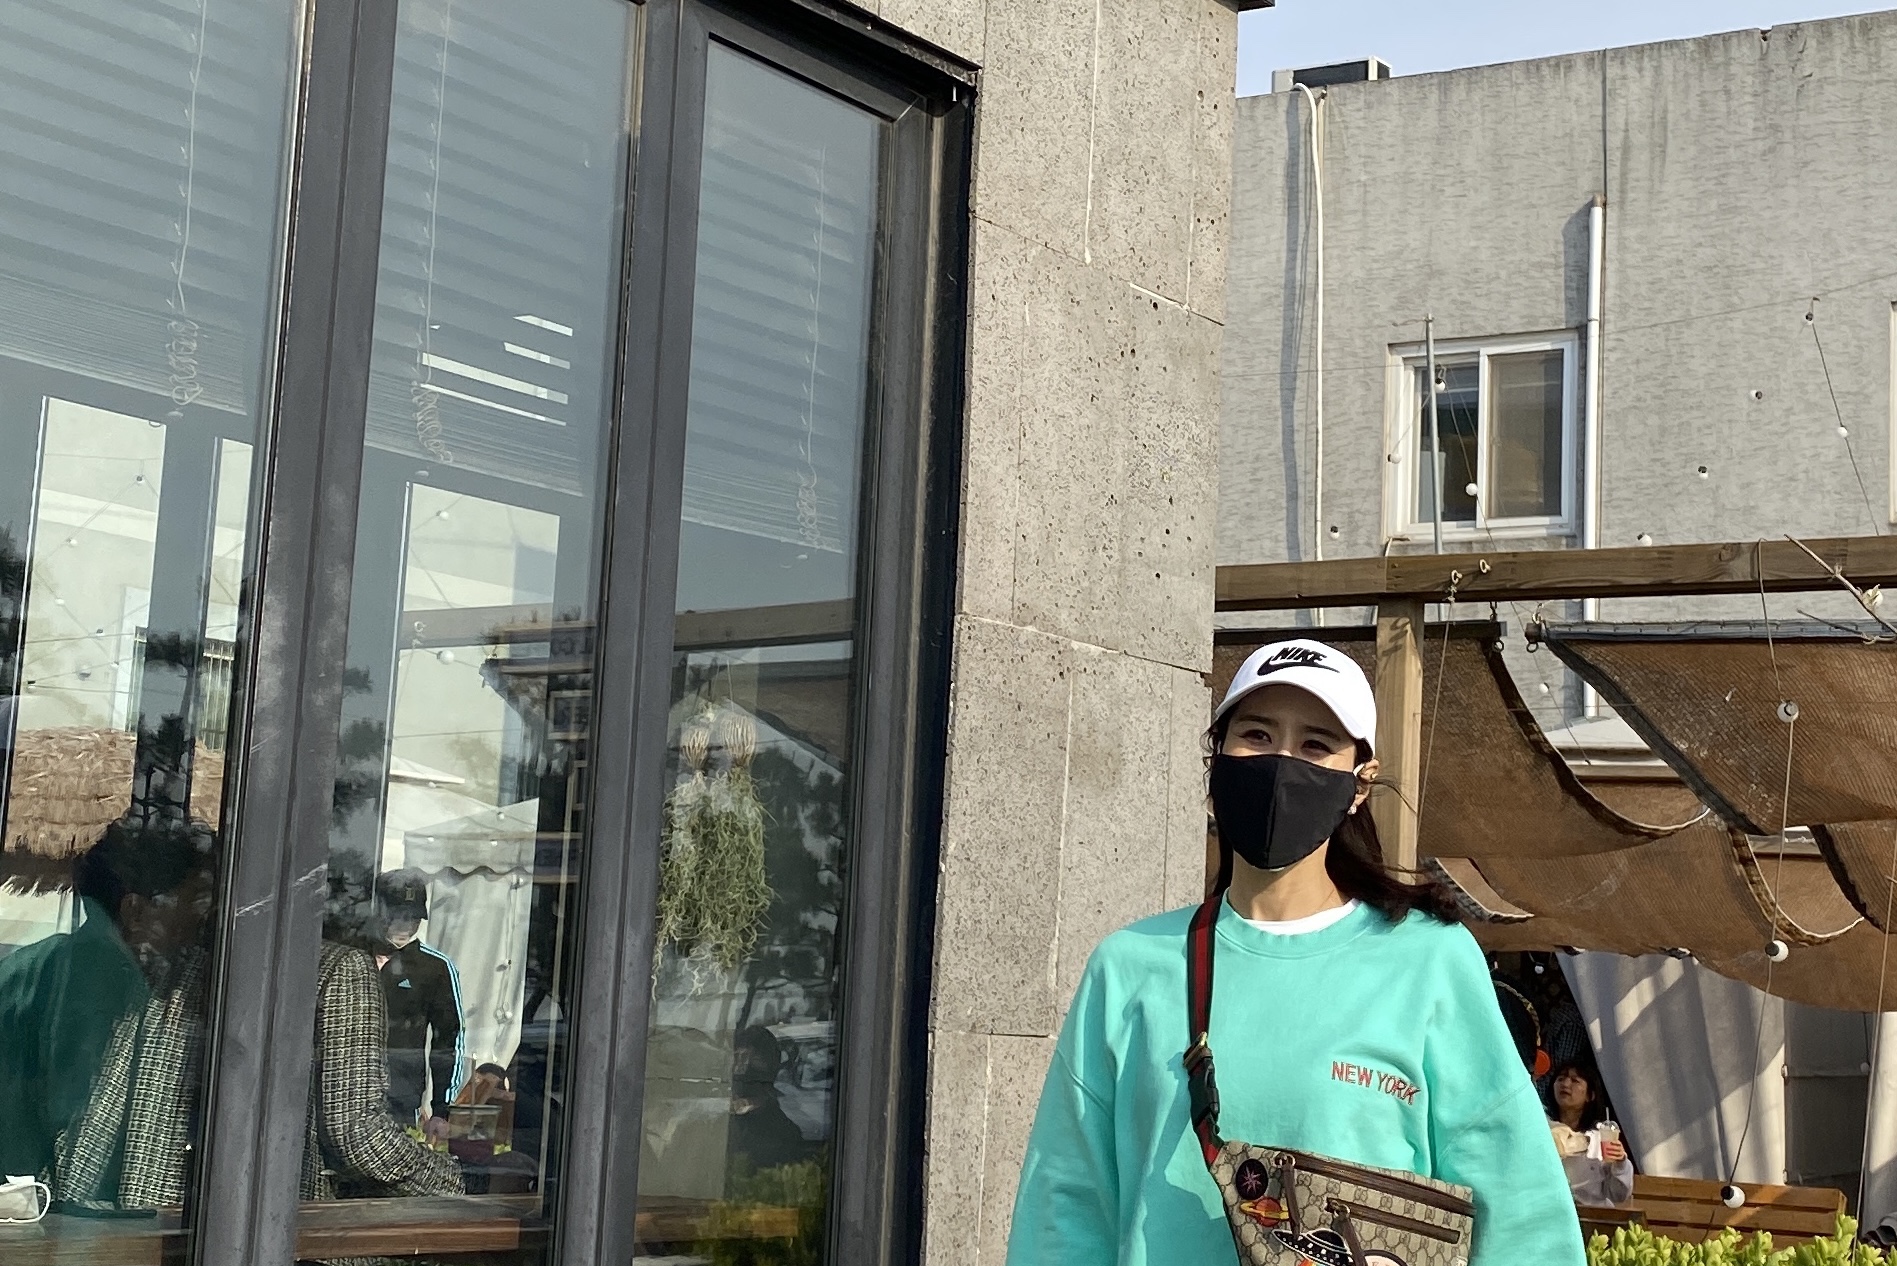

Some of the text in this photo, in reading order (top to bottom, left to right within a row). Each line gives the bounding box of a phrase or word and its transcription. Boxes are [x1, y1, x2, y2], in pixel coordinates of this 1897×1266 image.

[1271, 646, 1328, 663] NIKE
[1331, 1060, 1421, 1105] NEW YORK
